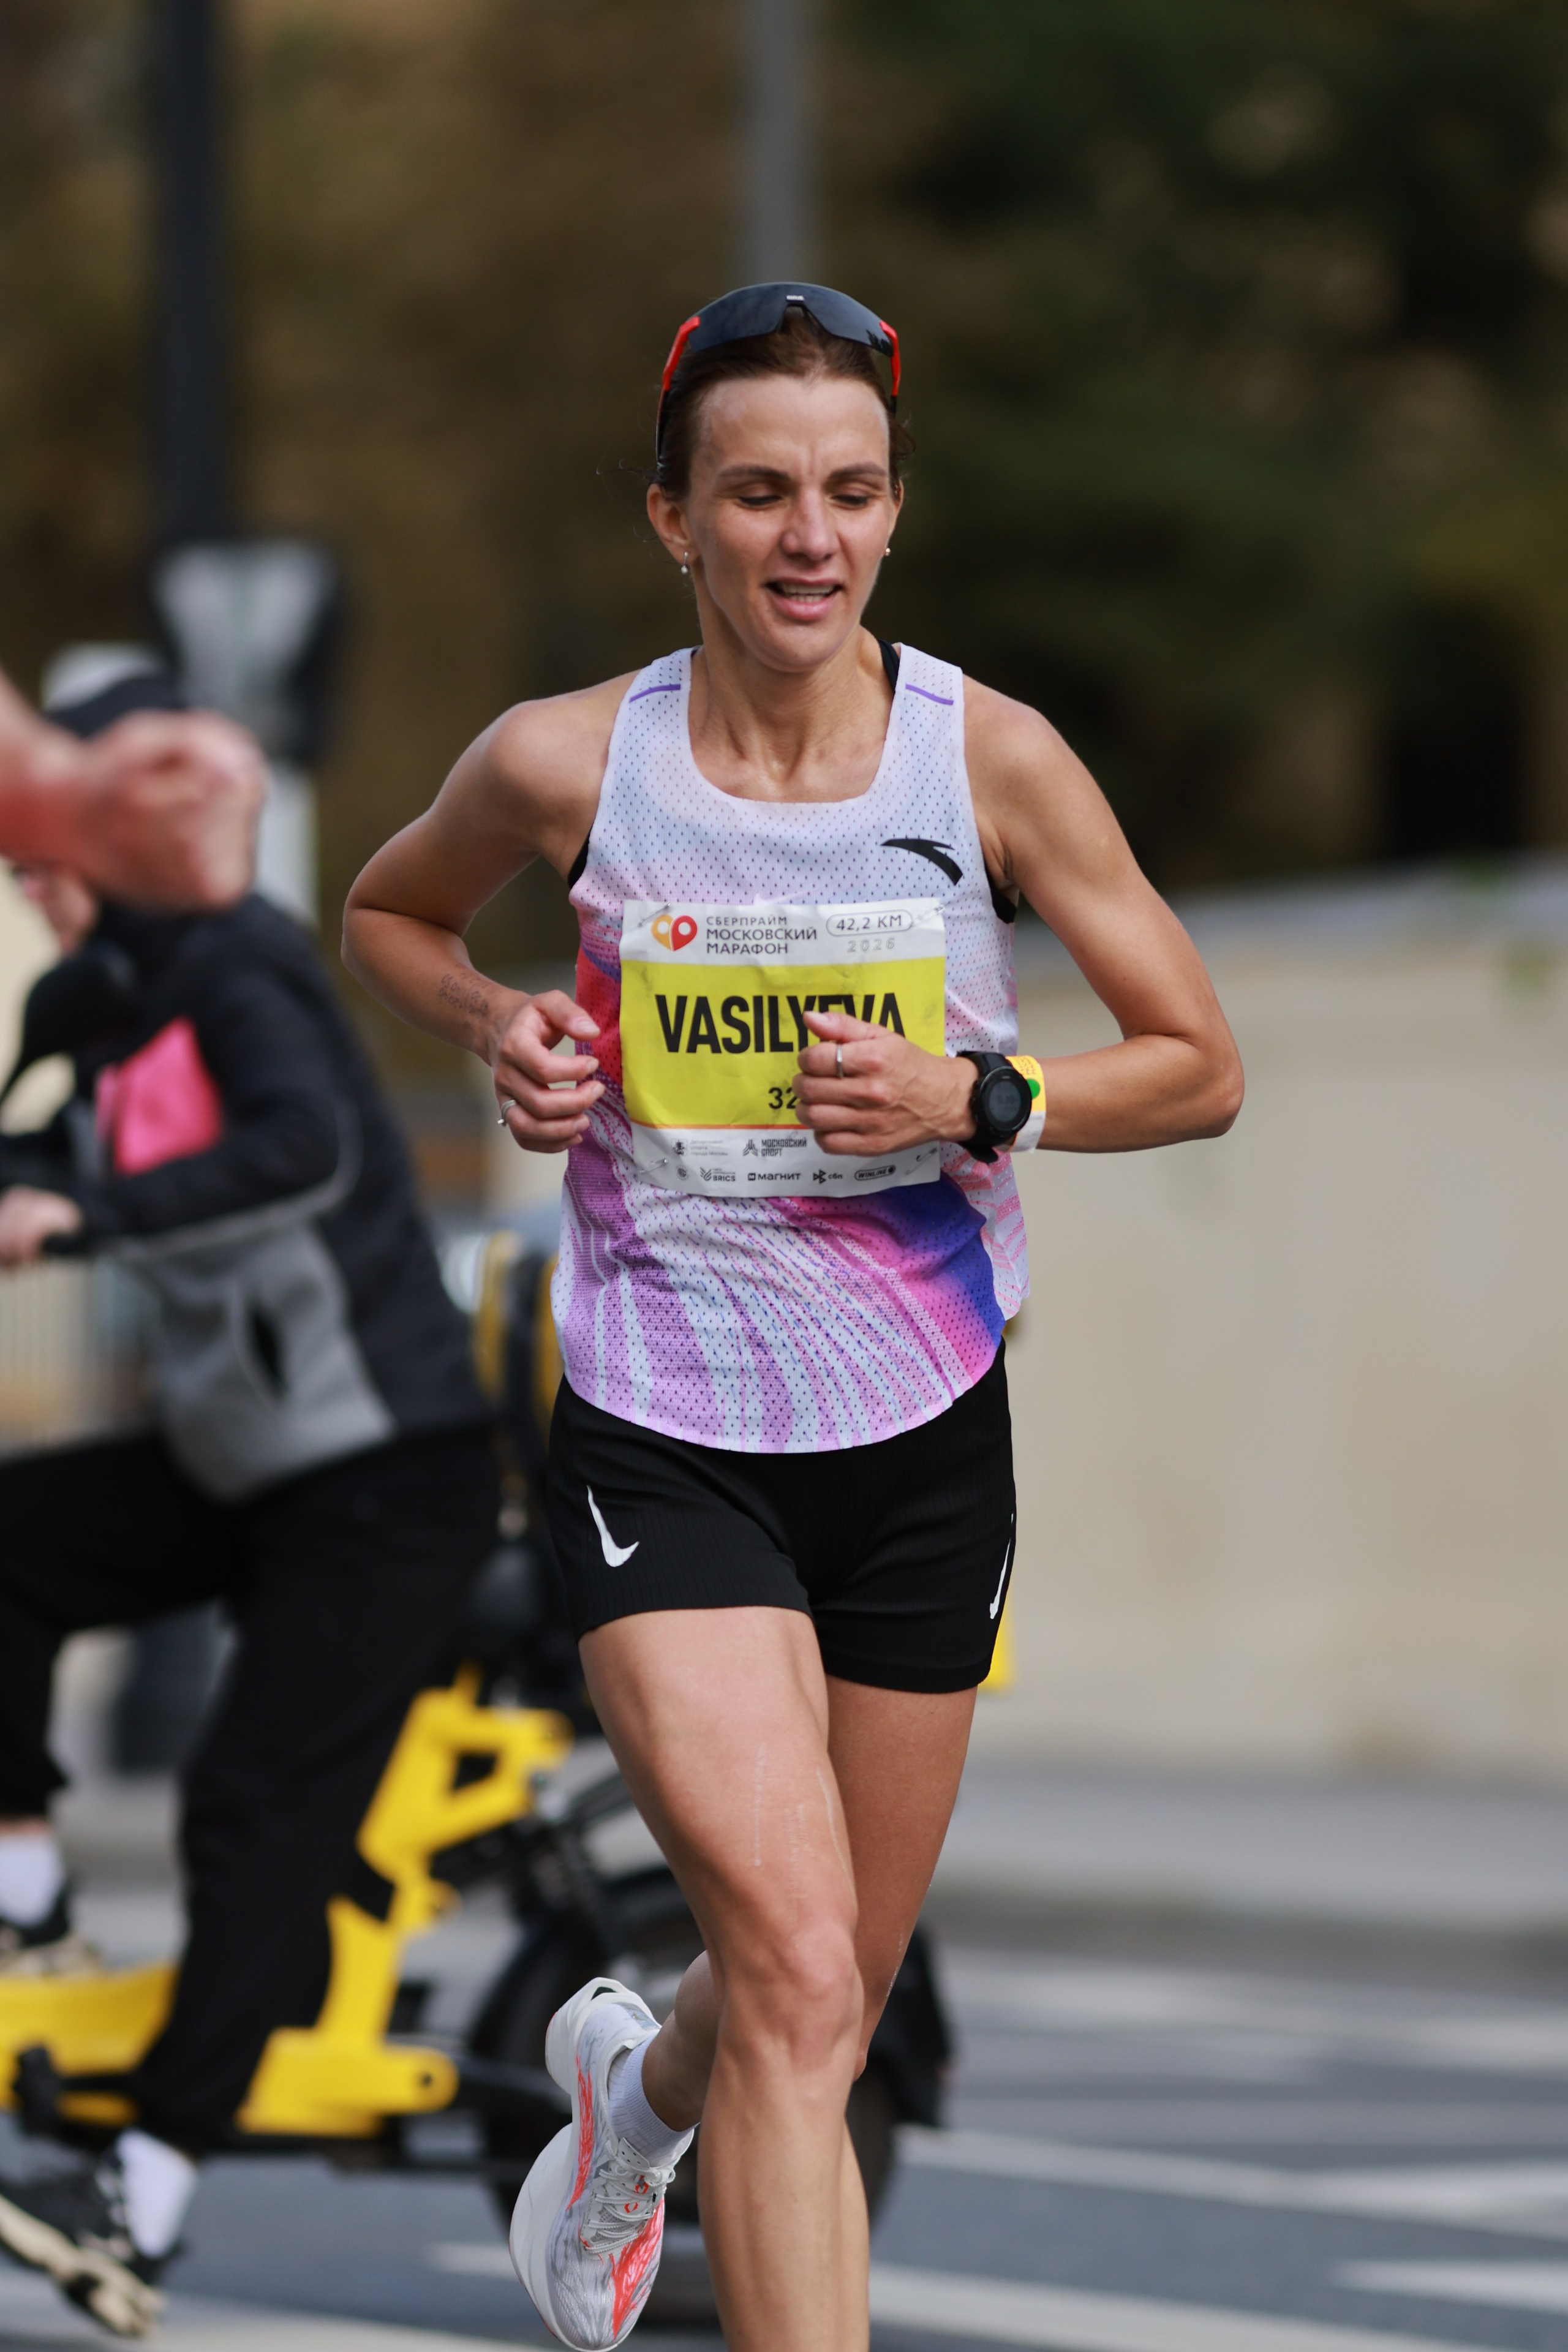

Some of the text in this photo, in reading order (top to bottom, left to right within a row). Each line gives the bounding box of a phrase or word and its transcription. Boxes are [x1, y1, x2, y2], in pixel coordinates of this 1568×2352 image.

[706, 914, 787, 926] СБЕРПРАЙМ
[836, 917, 870, 932] 42,2
[706, 927, 817, 941] МОСКОВСКИЙ
[706, 943, 788, 954] МАРАФОН
[846, 937, 895, 953] 2026
[761, 1137, 807, 1148] МОСКОВСКИЙ
[761, 1148, 783, 1157] СПОРТ
[858, 1169, 887, 1178] WINLINE
